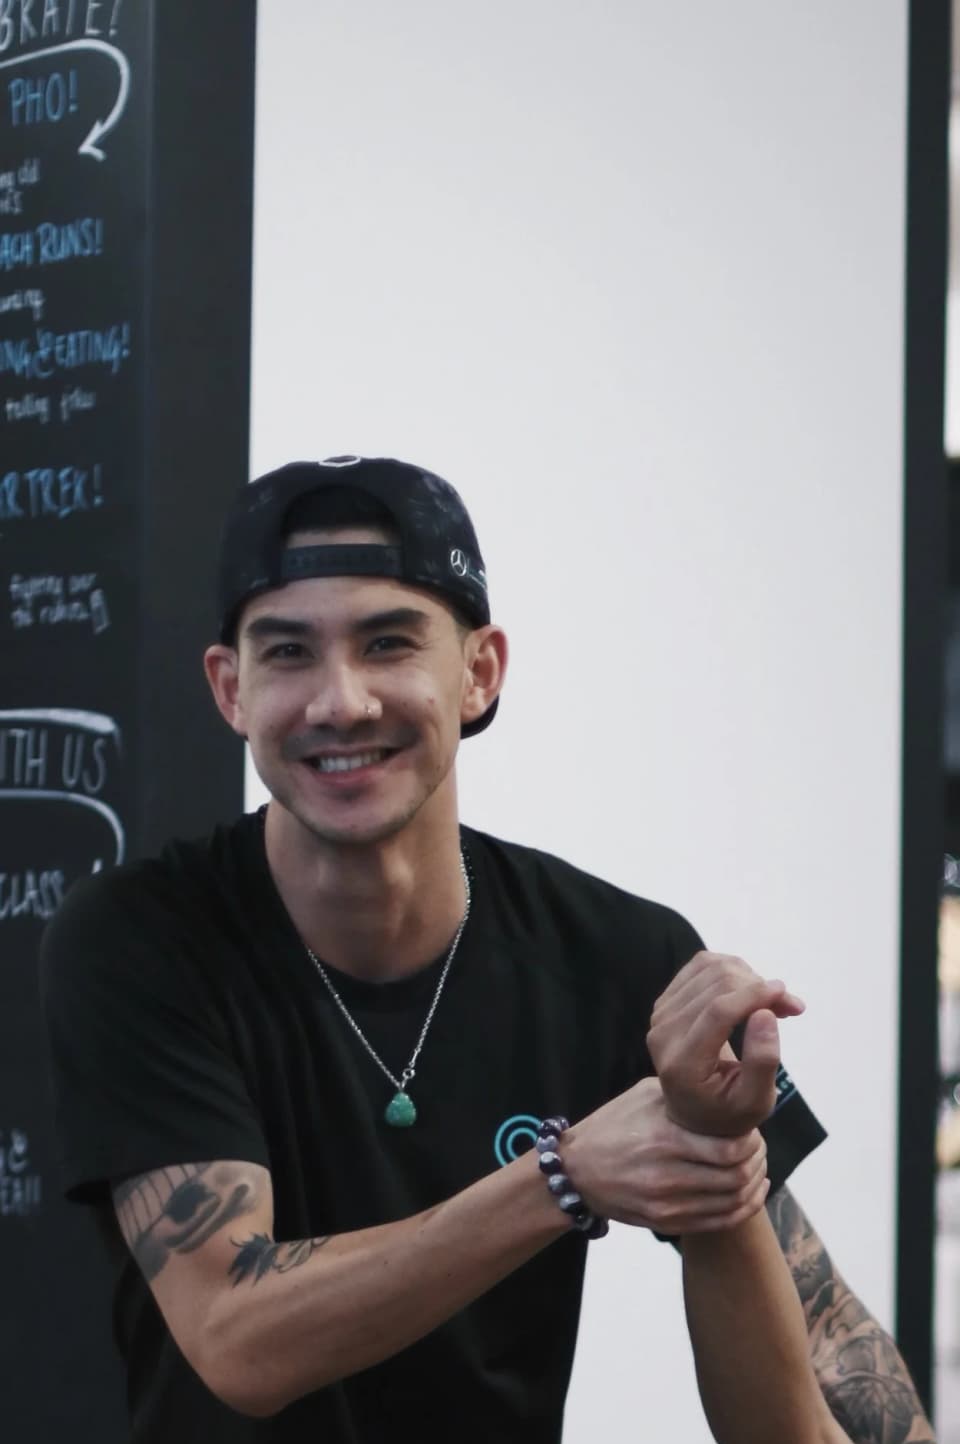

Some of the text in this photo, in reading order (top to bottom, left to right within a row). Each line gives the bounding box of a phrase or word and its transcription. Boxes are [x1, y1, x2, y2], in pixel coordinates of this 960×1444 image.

[9, 69, 78, 126] PHO!
[37, 216, 104, 264] RUNS!
[23, 463, 104, 518] TREK!
[61, 732, 106, 794] US
